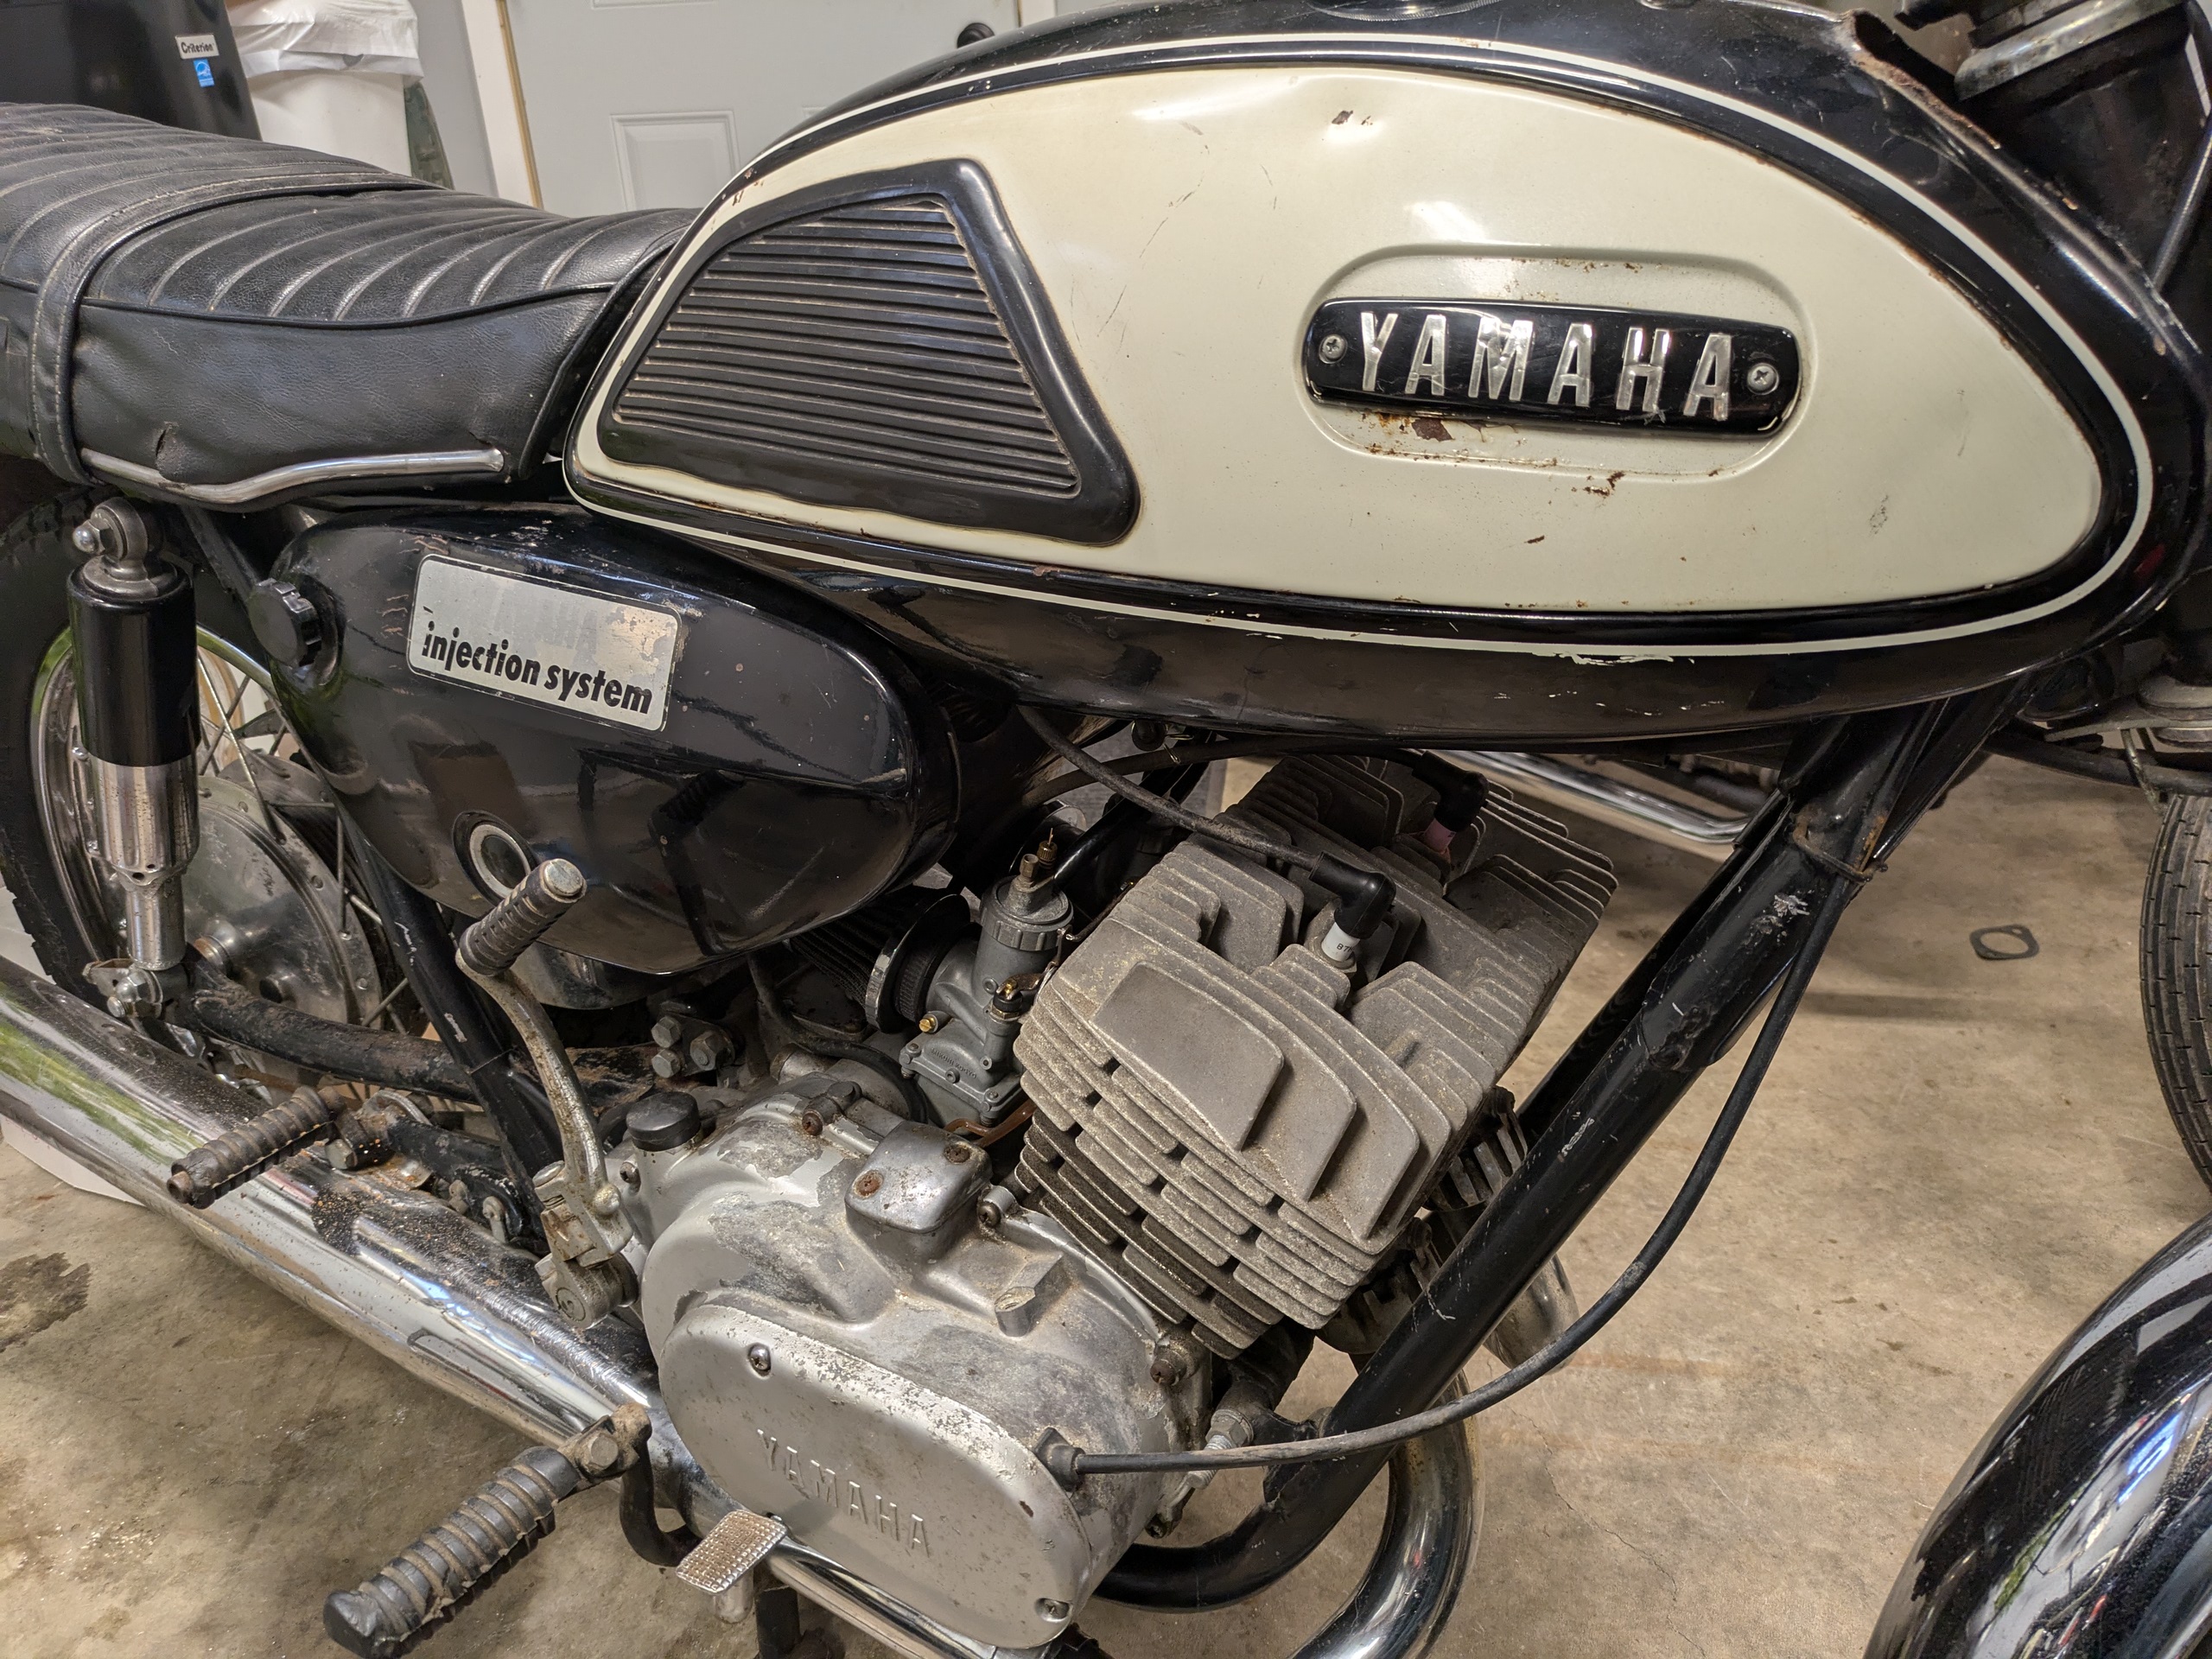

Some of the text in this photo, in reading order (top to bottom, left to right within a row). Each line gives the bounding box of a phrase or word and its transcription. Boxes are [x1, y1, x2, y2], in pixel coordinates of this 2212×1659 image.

[181, 41, 214, 54] Criterion
[1360, 311, 1733, 422] YAMAHA
[421, 620, 653, 715] injection system
[756, 1428, 931, 1559] YAMAHA
